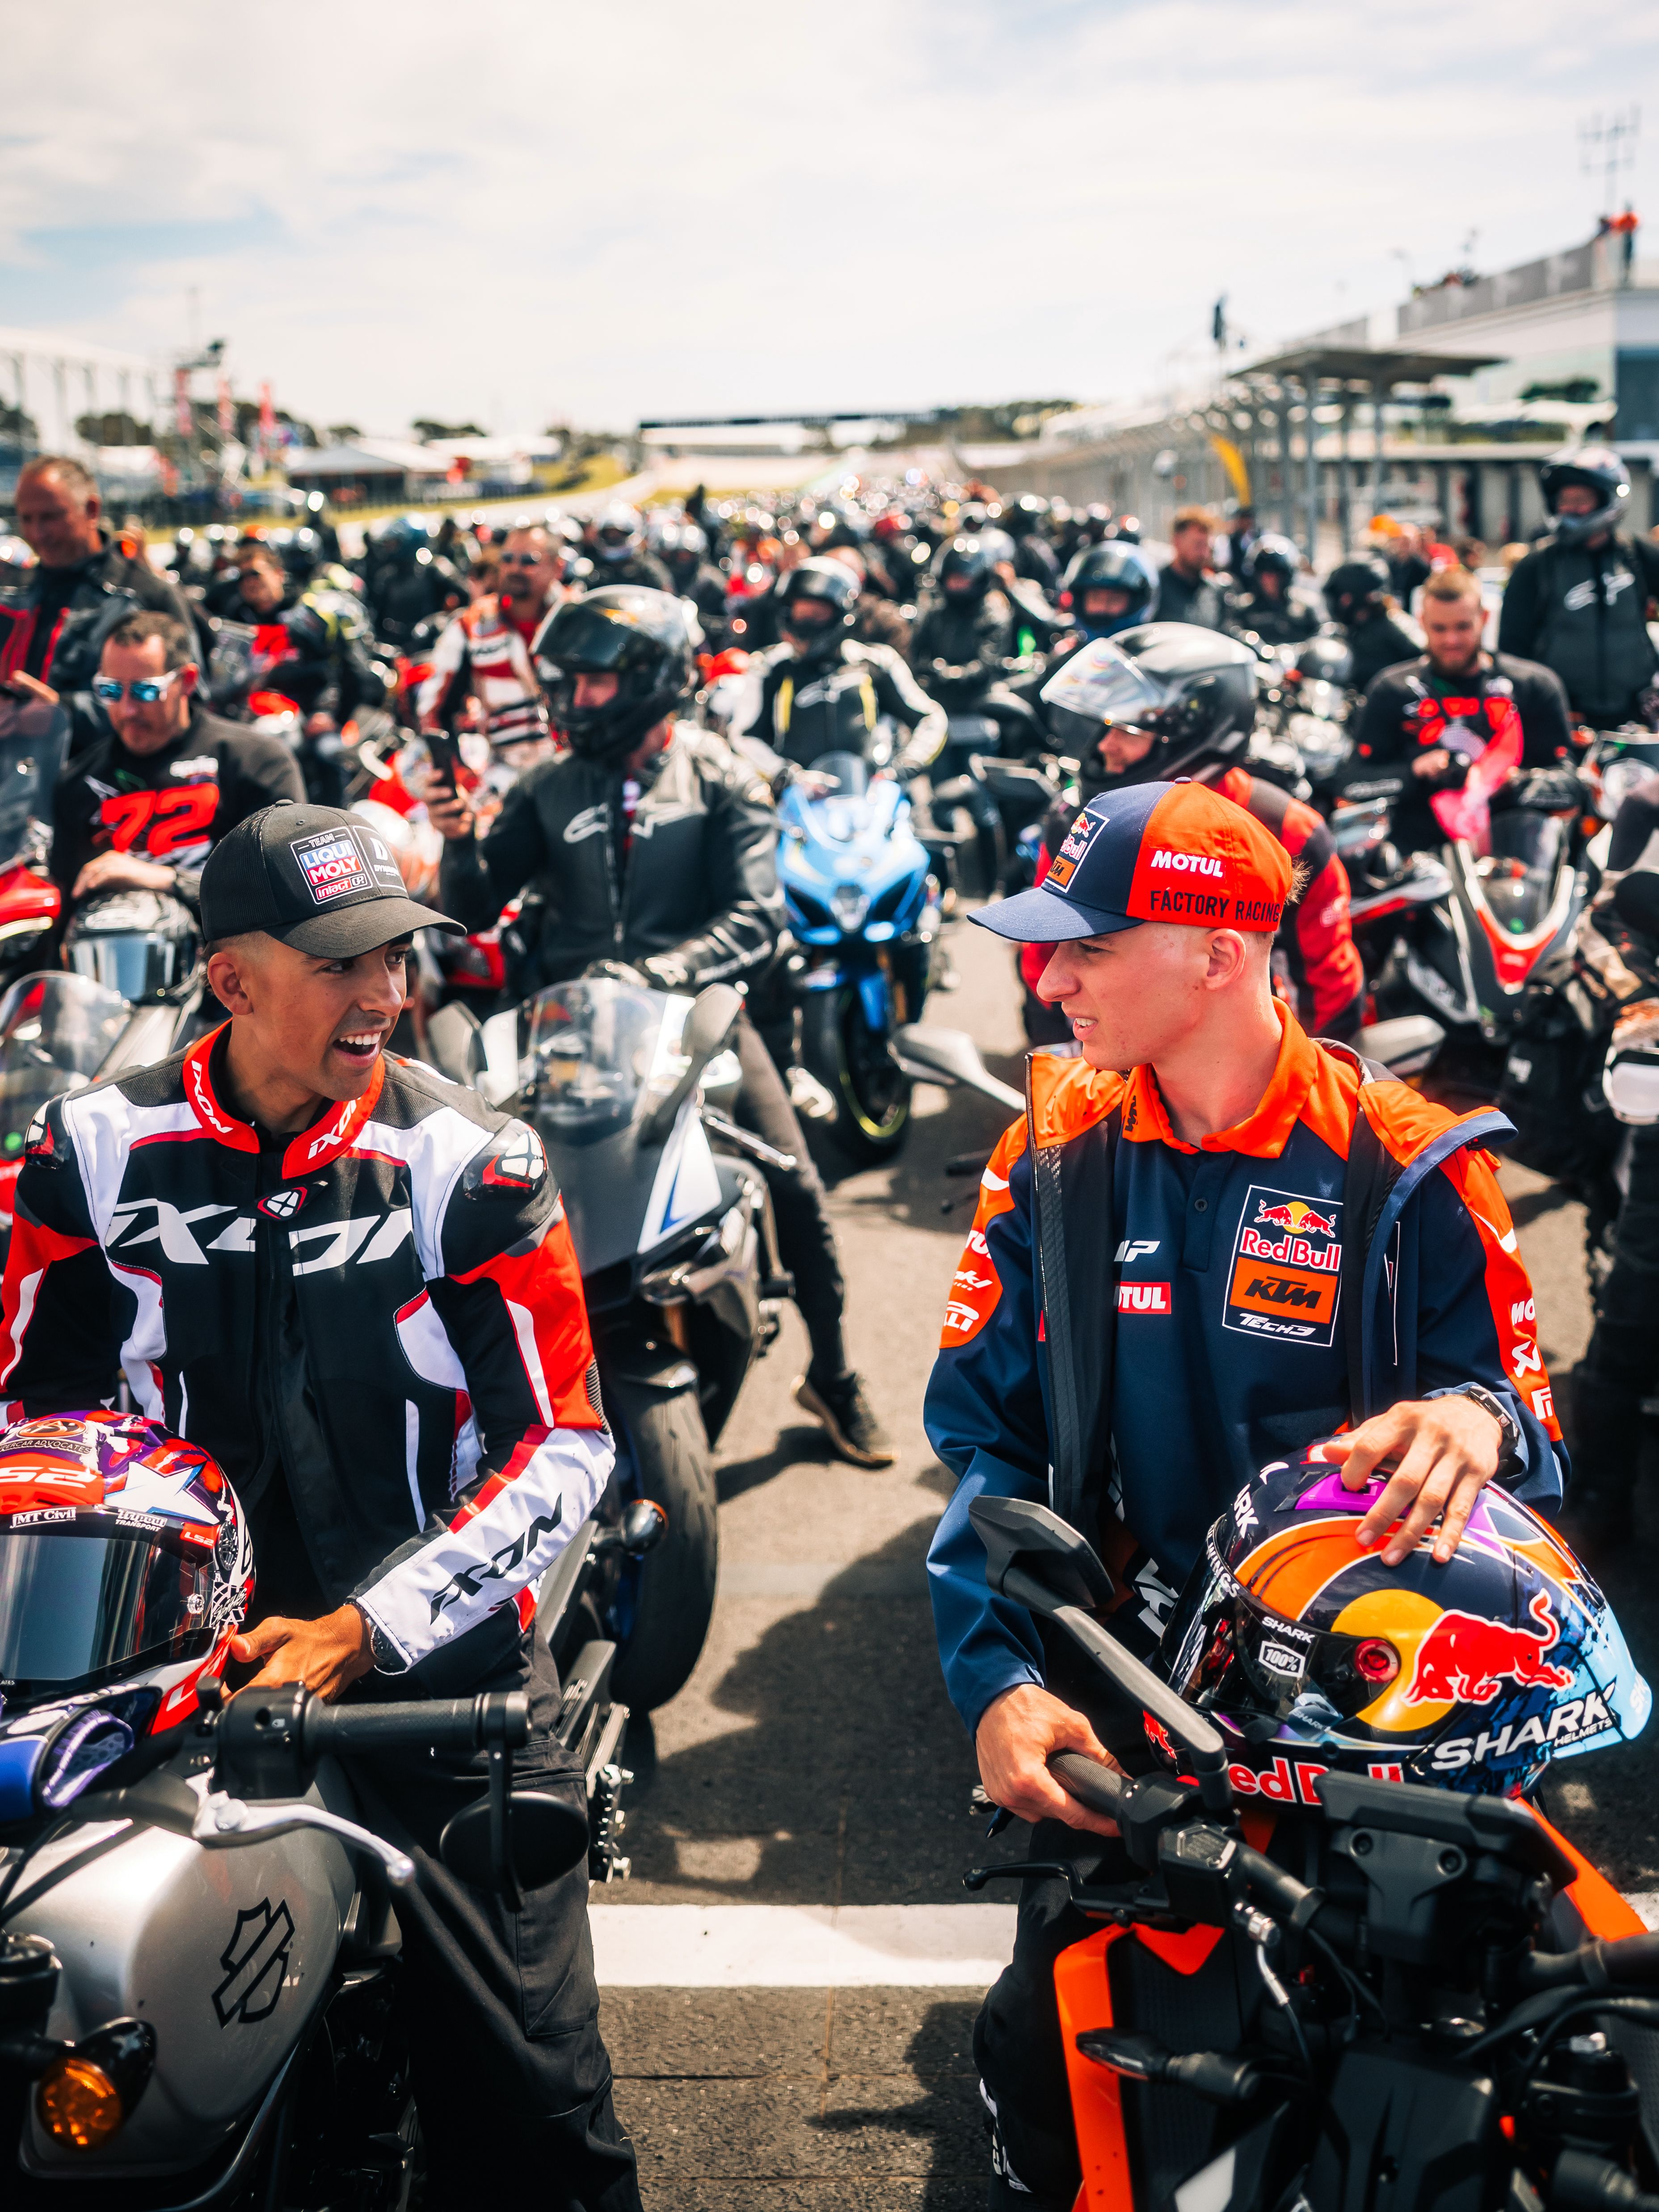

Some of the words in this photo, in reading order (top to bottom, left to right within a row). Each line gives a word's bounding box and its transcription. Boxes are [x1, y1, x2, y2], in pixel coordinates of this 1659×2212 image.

[101, 782, 219, 857] 72
[308, 833, 335, 848] TEAM
[1064, 835, 1088, 861] Bull
[303, 842, 354, 868] LIQUI
[1050, 860, 1065, 877] TM
[1150, 850, 1223, 877] MOTUL
[309, 855, 357, 883] MOLY
[1150, 890, 1230, 918] FACTORY
[1235, 900, 1280, 922] RACING
[191, 1060, 233, 1133] IXON
[1240, 1227, 1293, 1262] Red
[1291, 1238, 1342, 1272] Bull
[1244, 1276, 1322, 1309] KTM
[1512, 1298, 1535, 1326] MO
[34, 1440, 91, 1454] ADVOCATES
[0, 1466, 97, 1488] S2
[9, 1512, 42, 1529] JMT
[44, 1508, 76, 1520] Civil
[115, 1519, 161, 1532] TRANSPORT
[184, 1532, 214, 1546] LS2
[1262, 1616, 1315, 1644] SHARK
[1265, 1648, 1299, 1671] 100%
[1432, 1682, 1616, 1770] SHARK
[1554, 1717, 1613, 1747] HELMETS
[1229, 1757, 1297, 1803] ed
